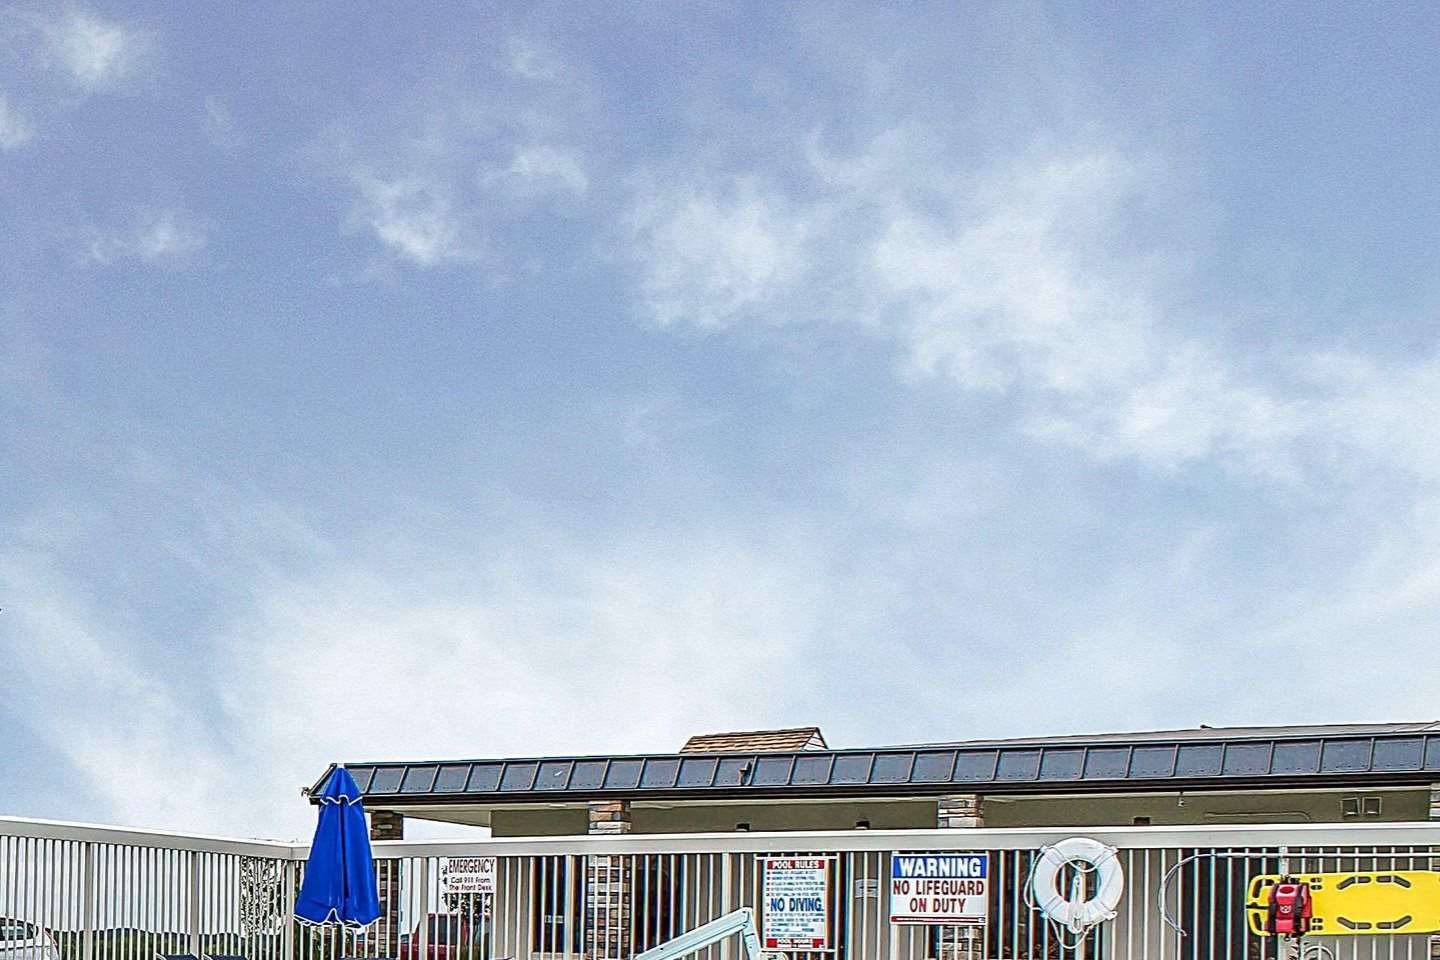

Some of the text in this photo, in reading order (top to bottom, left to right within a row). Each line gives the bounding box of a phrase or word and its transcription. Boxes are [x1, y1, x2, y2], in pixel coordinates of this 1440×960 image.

[449, 859, 495, 873] EMERGENCY
[772, 861, 820, 869] POOL RULES
[899, 858, 981, 877] WARNING
[893, 880, 984, 896] NO LIFEGUARD
[770, 898, 785, 912] NO
[910, 898, 966, 913] ON DUTY
